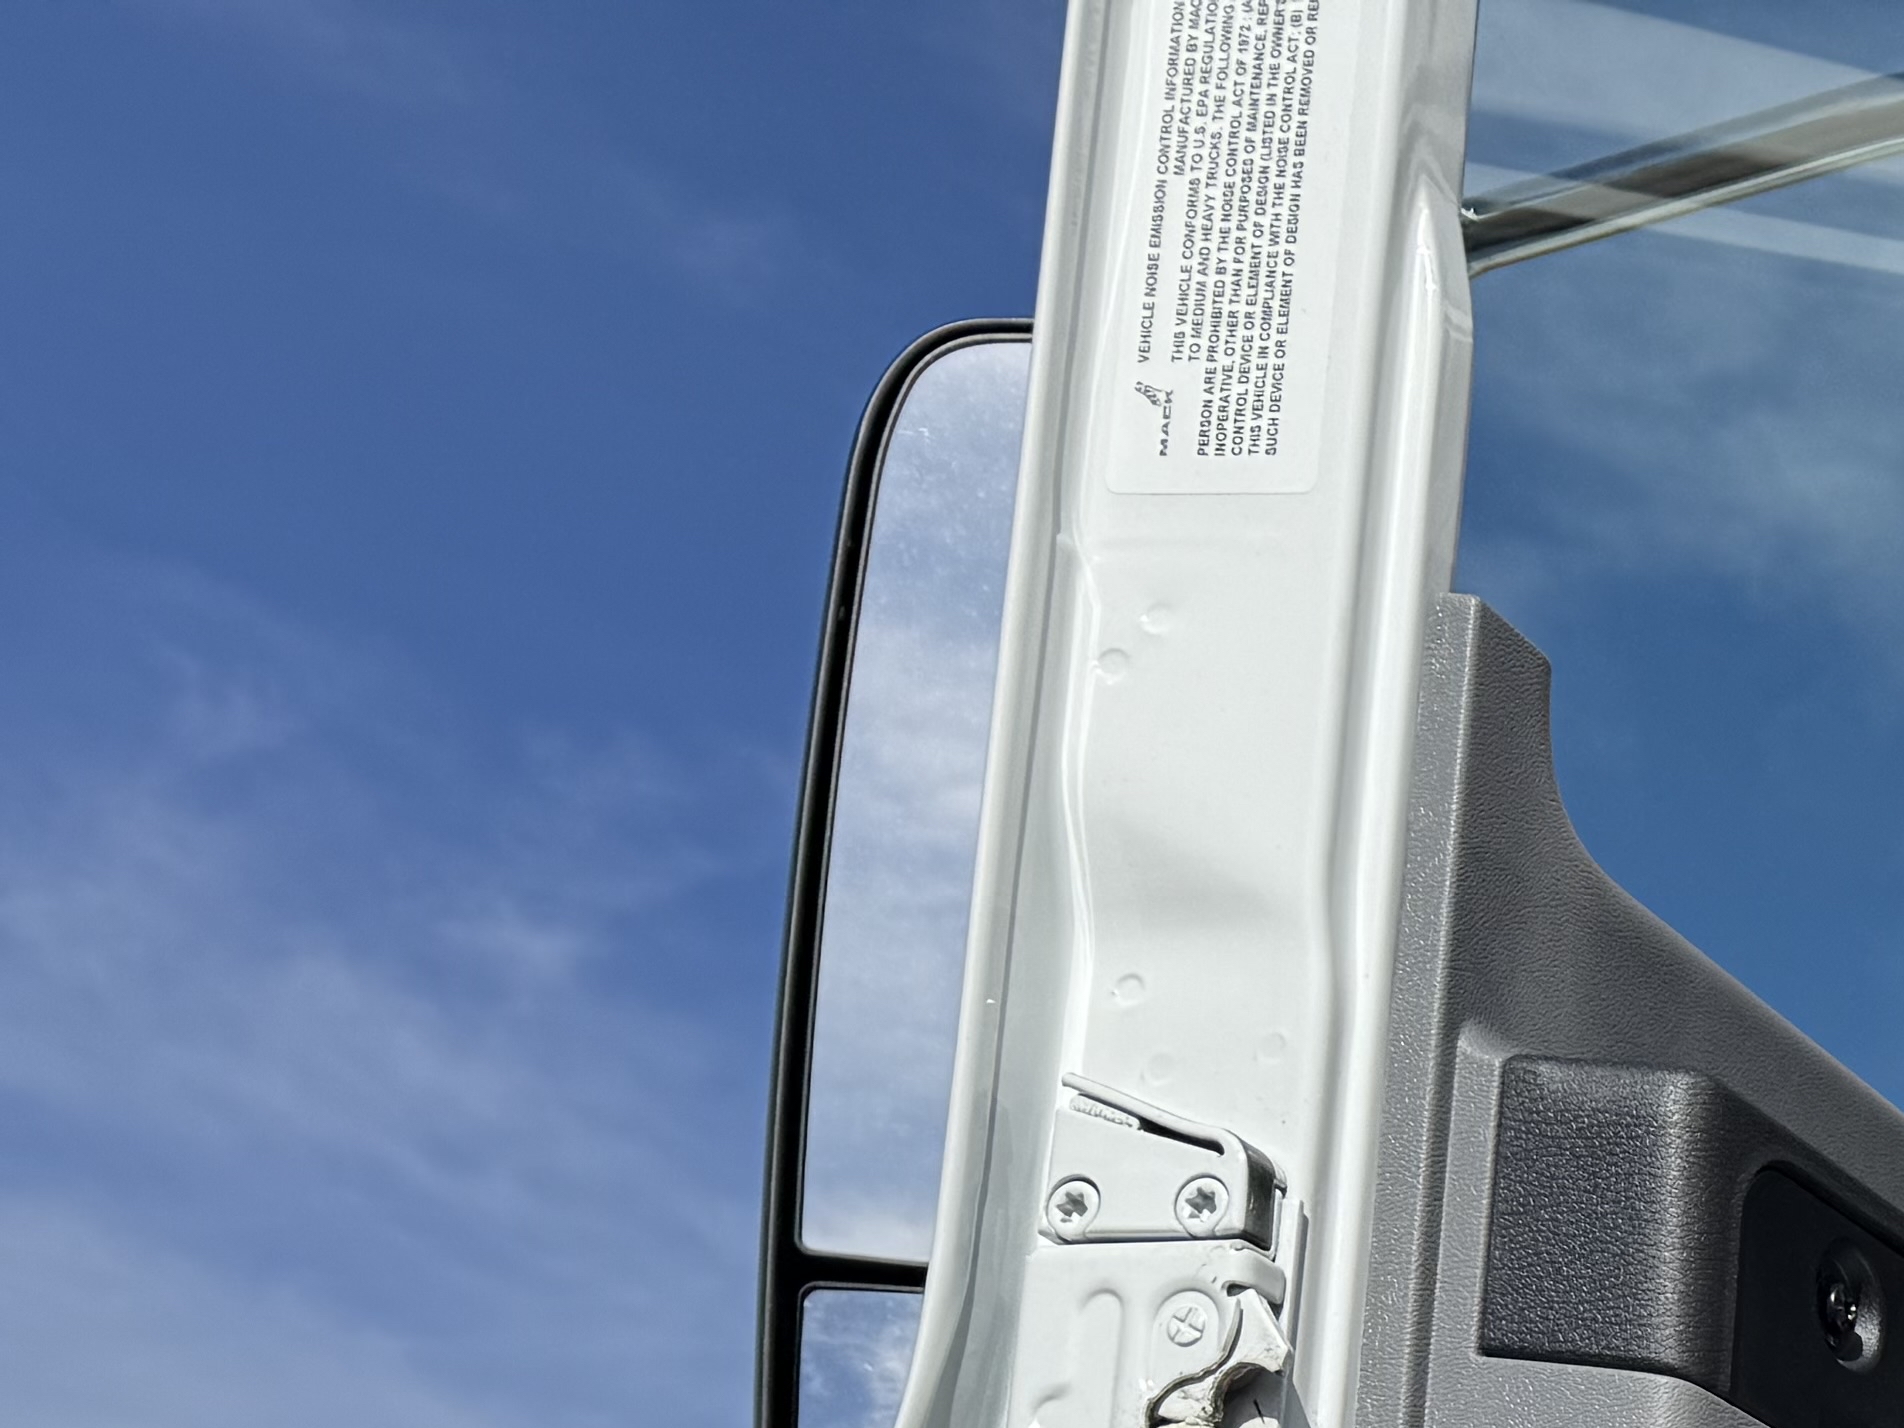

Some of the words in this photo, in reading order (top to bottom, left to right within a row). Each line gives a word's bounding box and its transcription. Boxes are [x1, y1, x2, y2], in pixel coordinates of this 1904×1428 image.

[1306, 0, 1320, 21] RE
[1198, 0, 1219, 84] REGULATIO
[1214, 3, 1235, 90] FOLLOWING
[1304, 25, 1317, 45] OR
[1195, 88, 1209, 117] EPA
[1297, 48, 1315, 116] REMOVED
[1211, 94, 1226, 122] THE
[1156, 104, 1175, 175] CONTROL
[1292, 119, 1308, 157] BEEN
[1189, 152, 1203, 172] TO
[1290, 160, 1304, 189] HAS
[1148, 178, 1168, 248] EMISSION
[1181, 177, 1201, 260] CONFORMS
[1200, 193, 1216, 242] HEAVY
[1284, 192, 1301, 244] DESIGN
[1143, 252, 1160, 297] NOISE
[1196, 245, 1211, 277] AND
[1282, 248, 1295, 267] OF
[1174, 264, 1193, 326] VEHICLE
[1189, 280, 1207, 339] MEDIUM
[1275, 270, 1294, 335] ELEMENT
[1136, 300, 1155, 363] VEHICLE
[1170, 330, 1186, 363] THIS
[1187, 342, 1201, 362] TO
[1273, 338, 1287, 359] OR
[1268, 362, 1285, 413] DEVICE
[1158, 389, 1174, 456] MACK
[1264, 416, 1279, 456] SUCH
